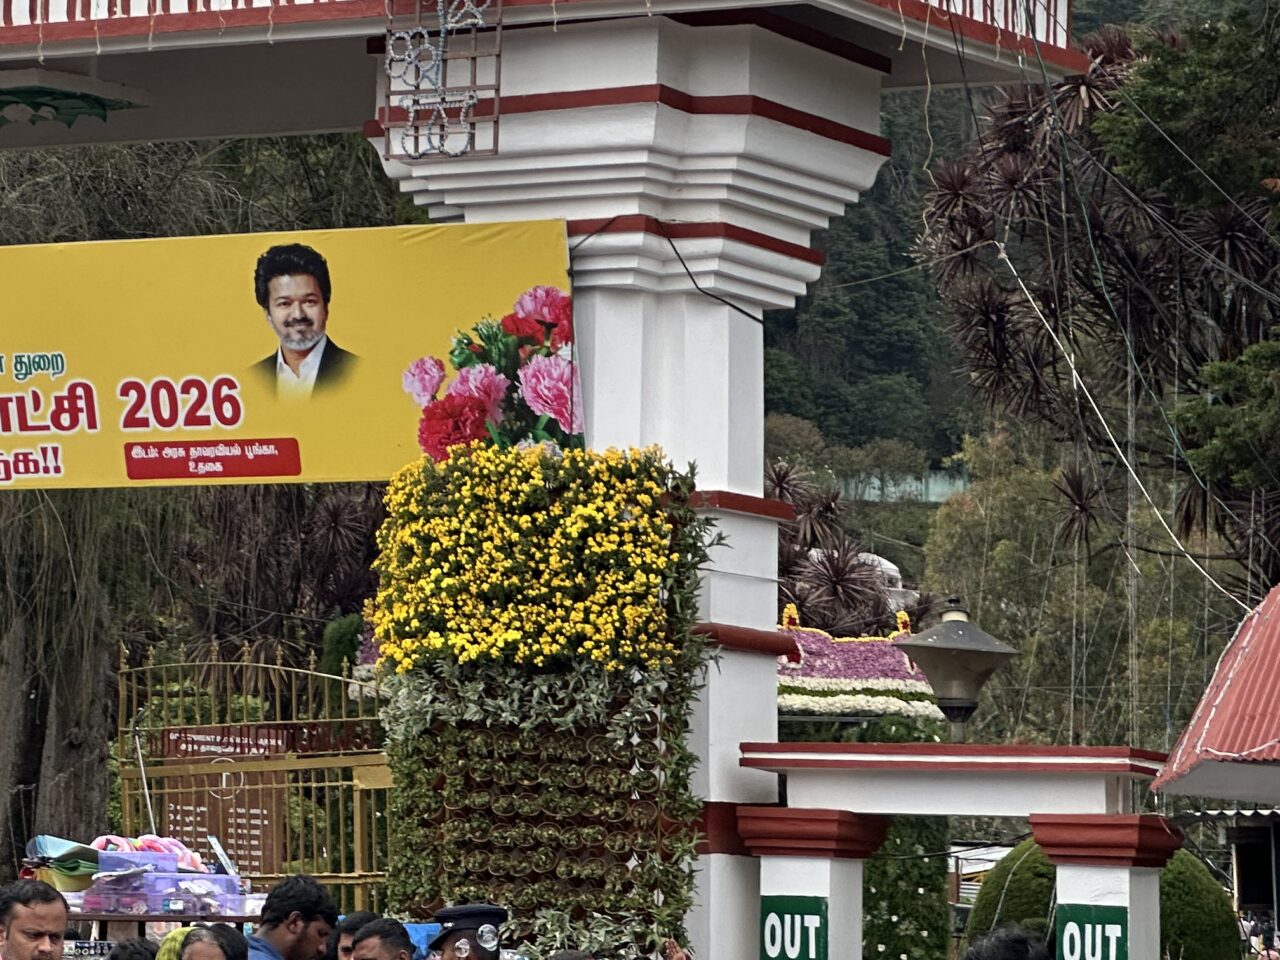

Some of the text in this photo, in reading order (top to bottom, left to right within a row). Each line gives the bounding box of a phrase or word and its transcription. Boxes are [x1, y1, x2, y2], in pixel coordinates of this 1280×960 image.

[13, 351, 65, 380] துறை
[119, 377, 241, 429] 2026
[764, 911, 820, 959] OUT
[1062, 921, 1123, 960] OUT
